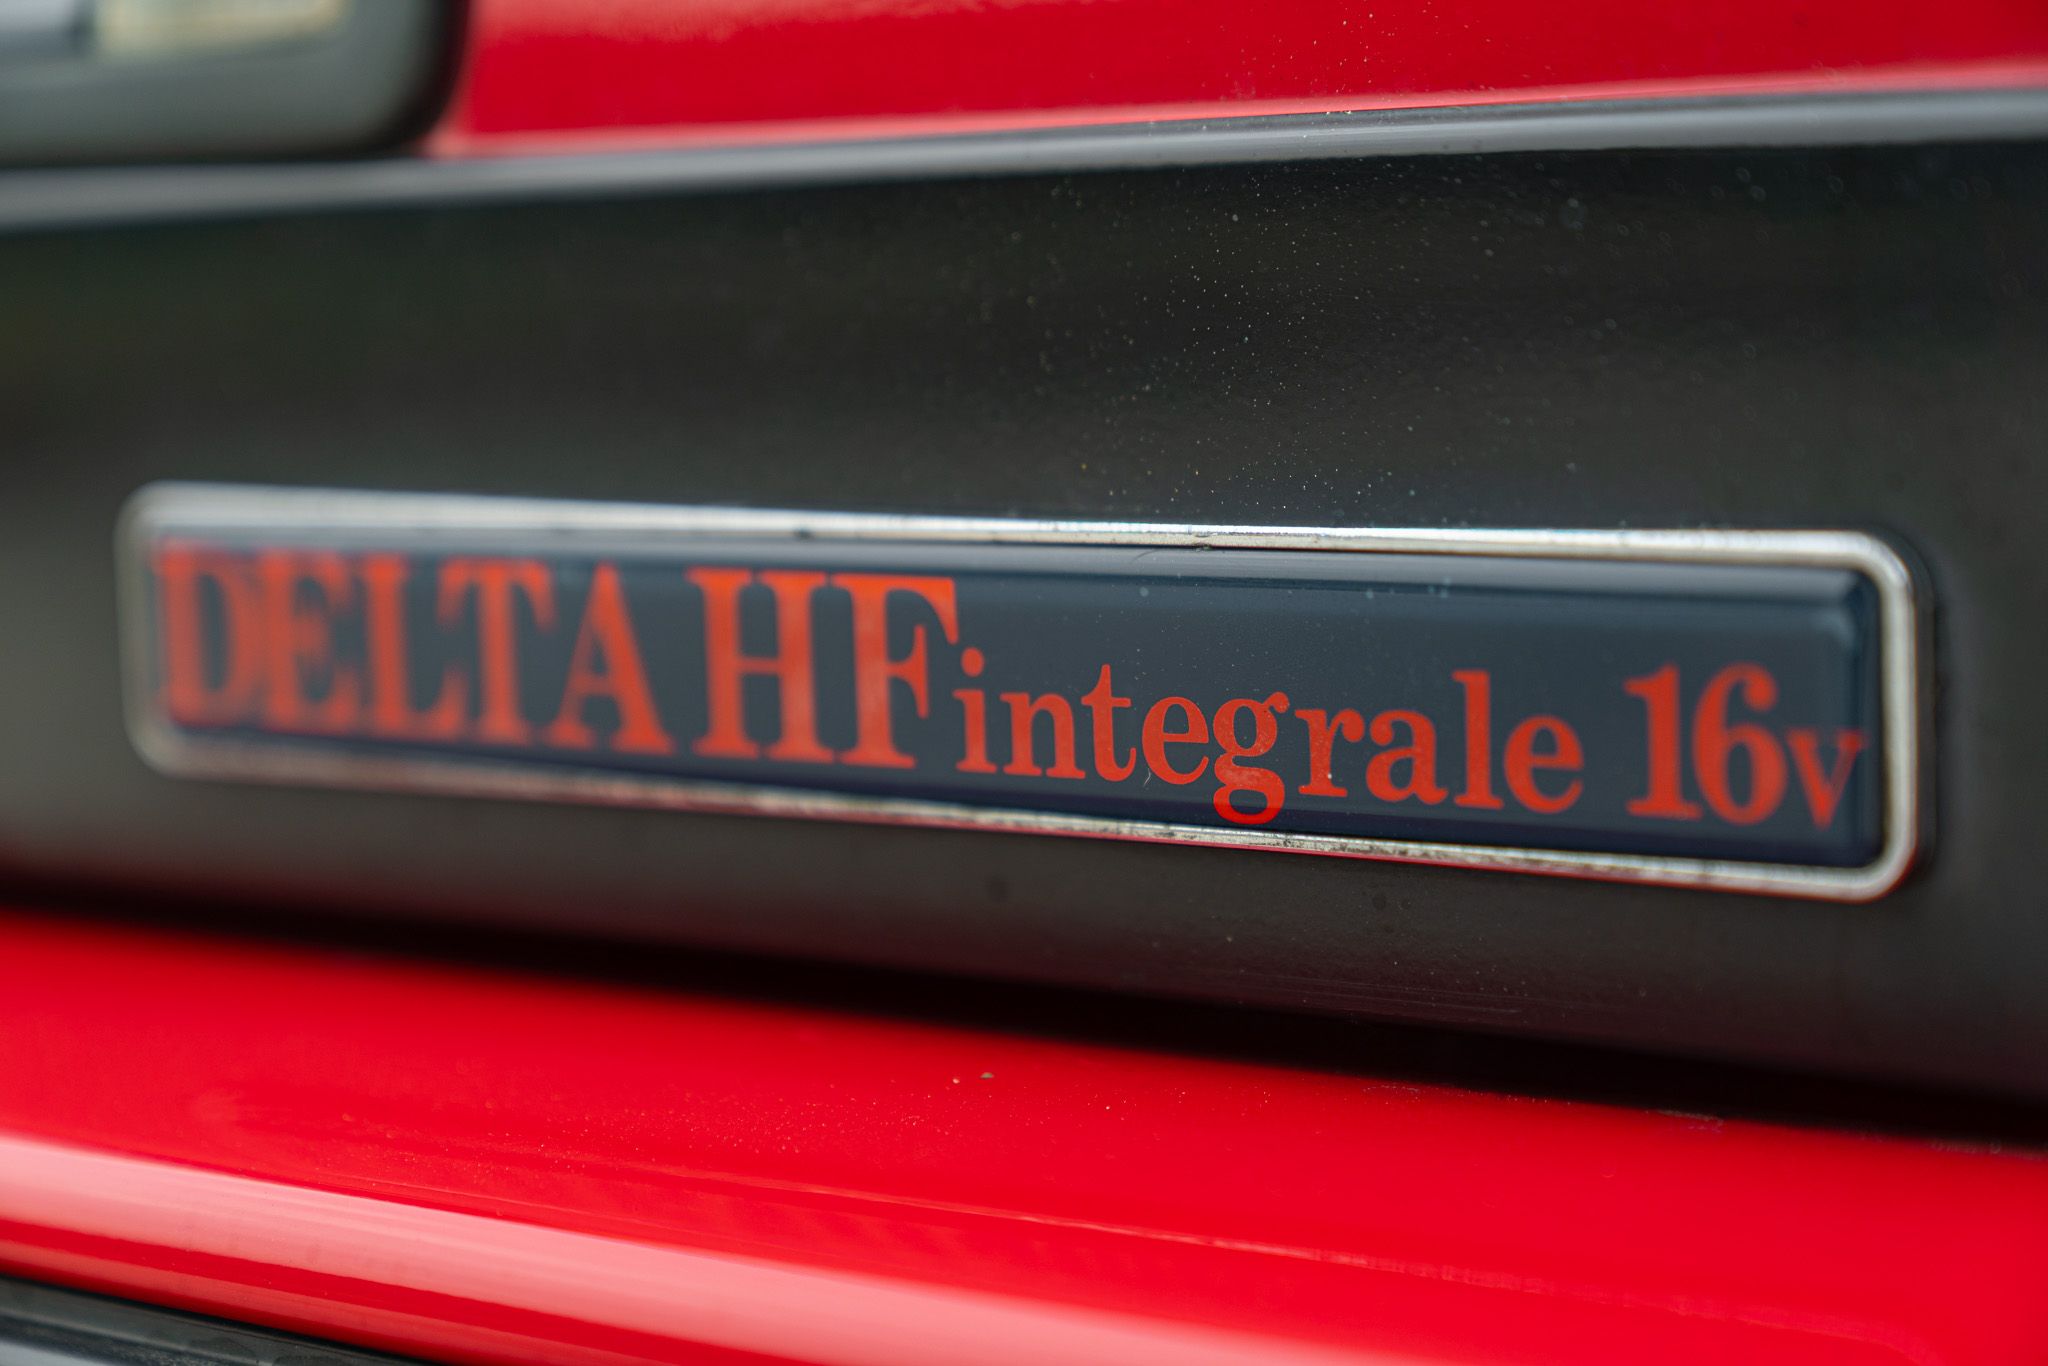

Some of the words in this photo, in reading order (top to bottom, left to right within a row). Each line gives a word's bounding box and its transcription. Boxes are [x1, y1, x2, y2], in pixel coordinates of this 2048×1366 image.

[155, 541, 675, 755] DELTA
[687, 567, 959, 769] HF
[953, 648, 1584, 825] integrale
